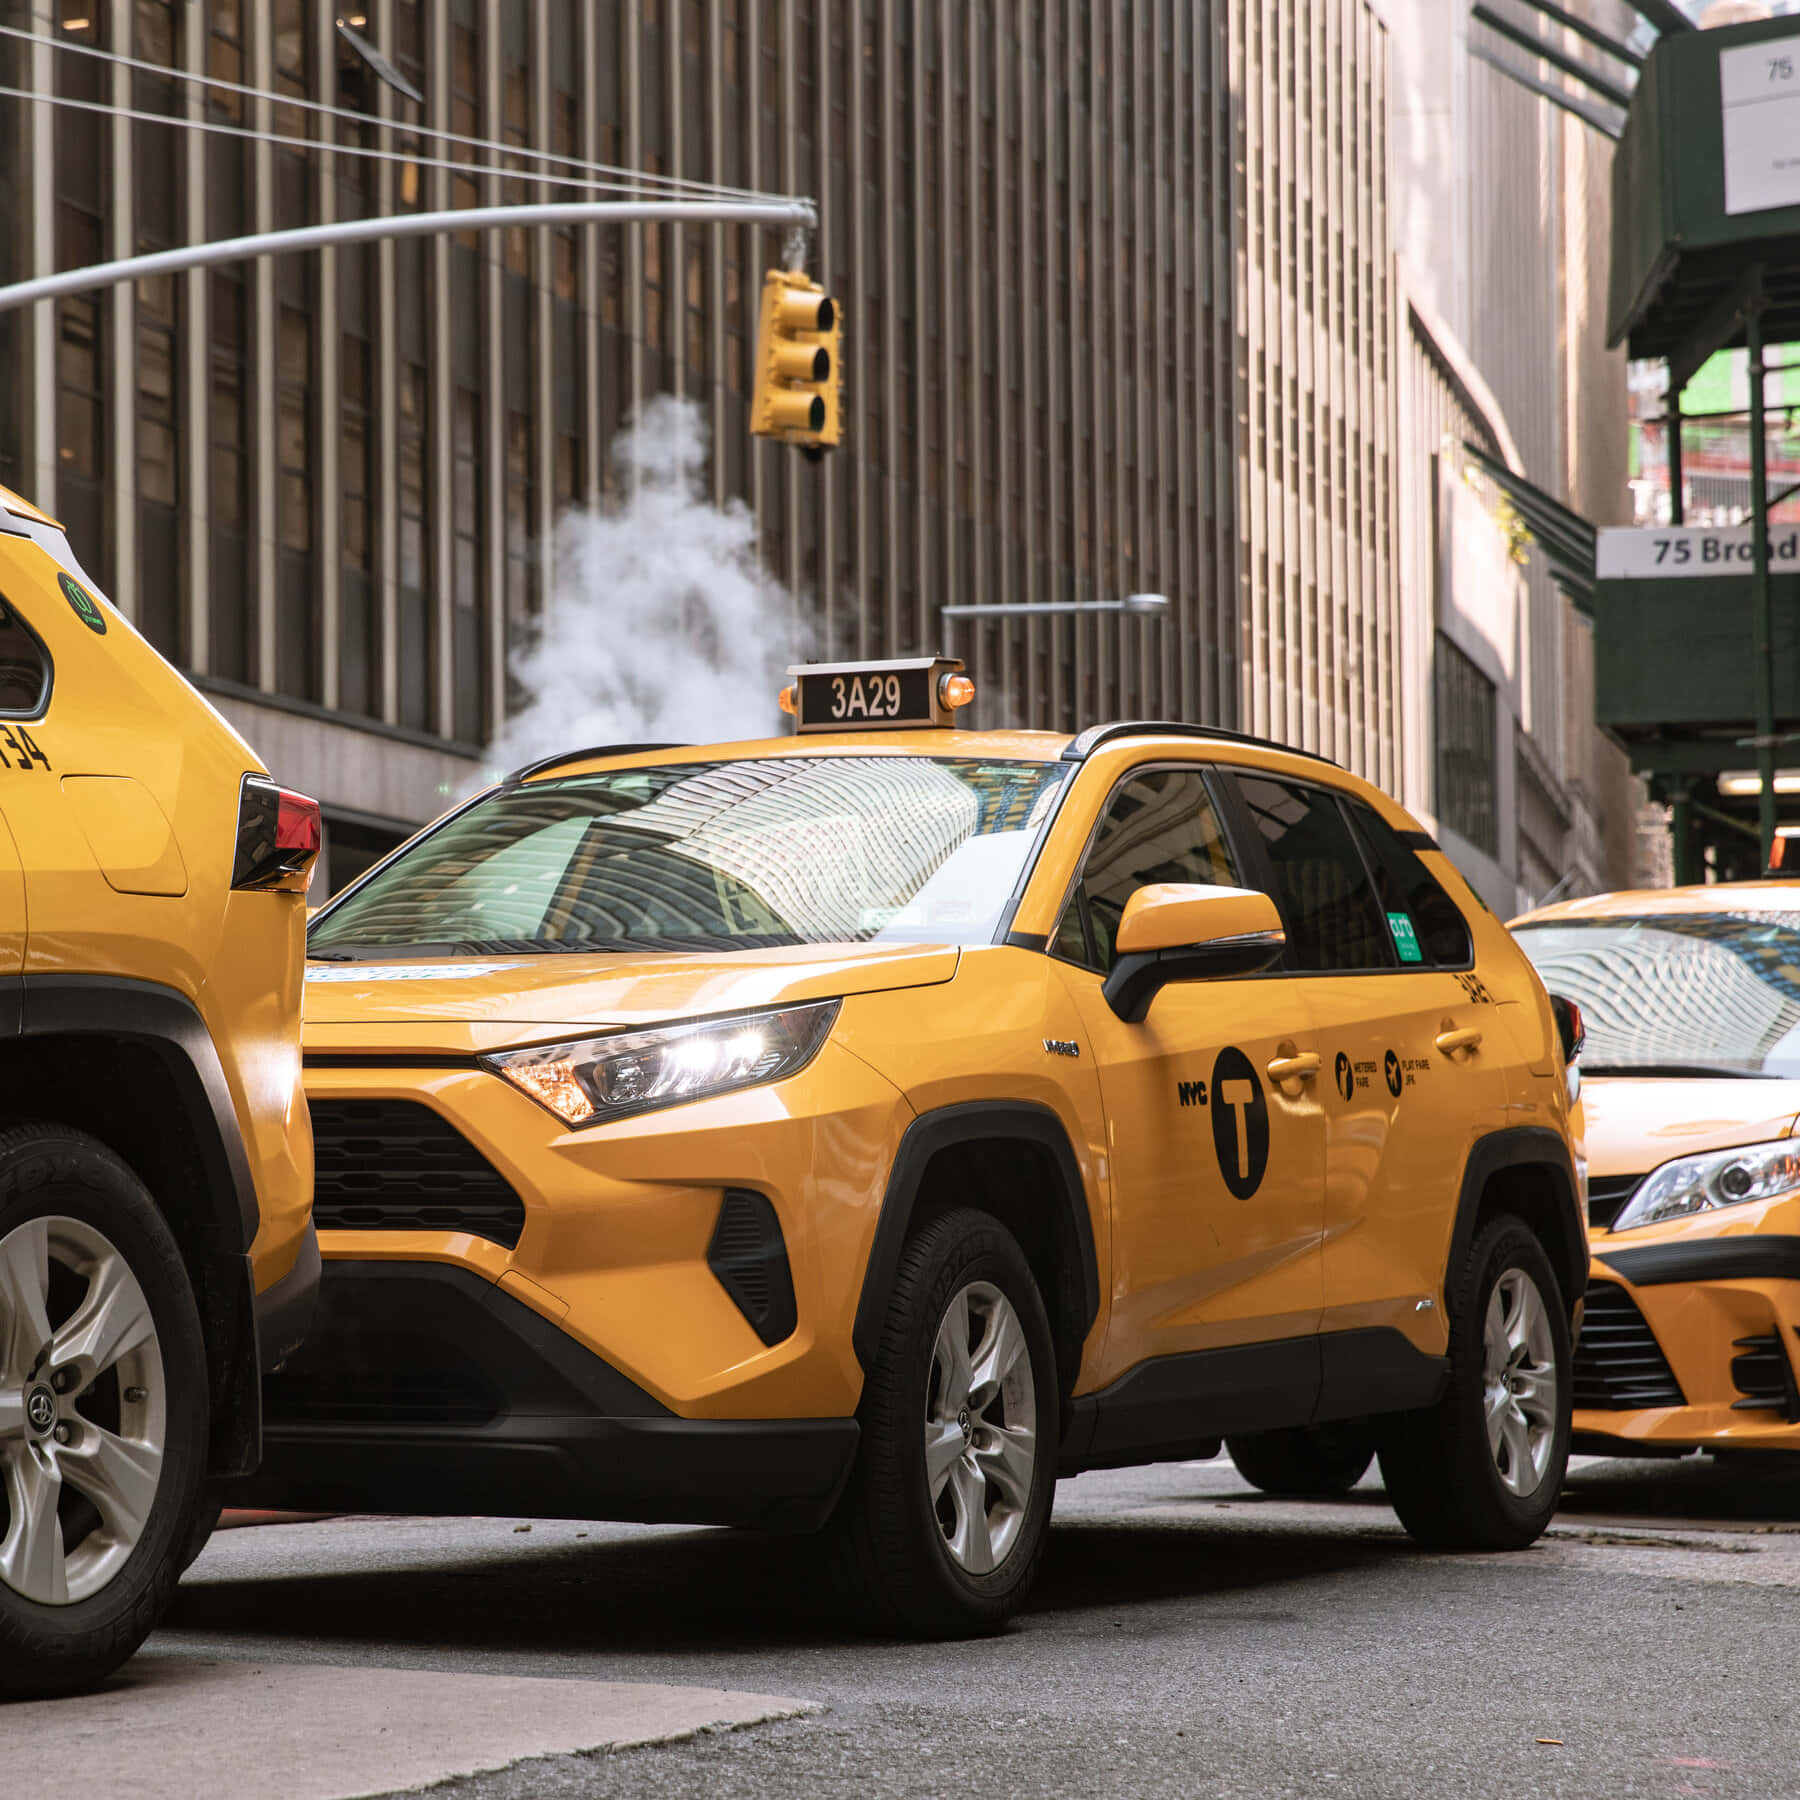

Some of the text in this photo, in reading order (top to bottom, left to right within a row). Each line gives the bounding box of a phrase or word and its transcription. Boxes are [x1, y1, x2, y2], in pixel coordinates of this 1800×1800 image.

[1767, 57, 1794, 82] 75
[1653, 539, 1691, 565] 75
[831, 674, 901, 718] 3A29
[0, 724, 52, 771] 34
[1178, 1080, 1208, 1107] NYC
